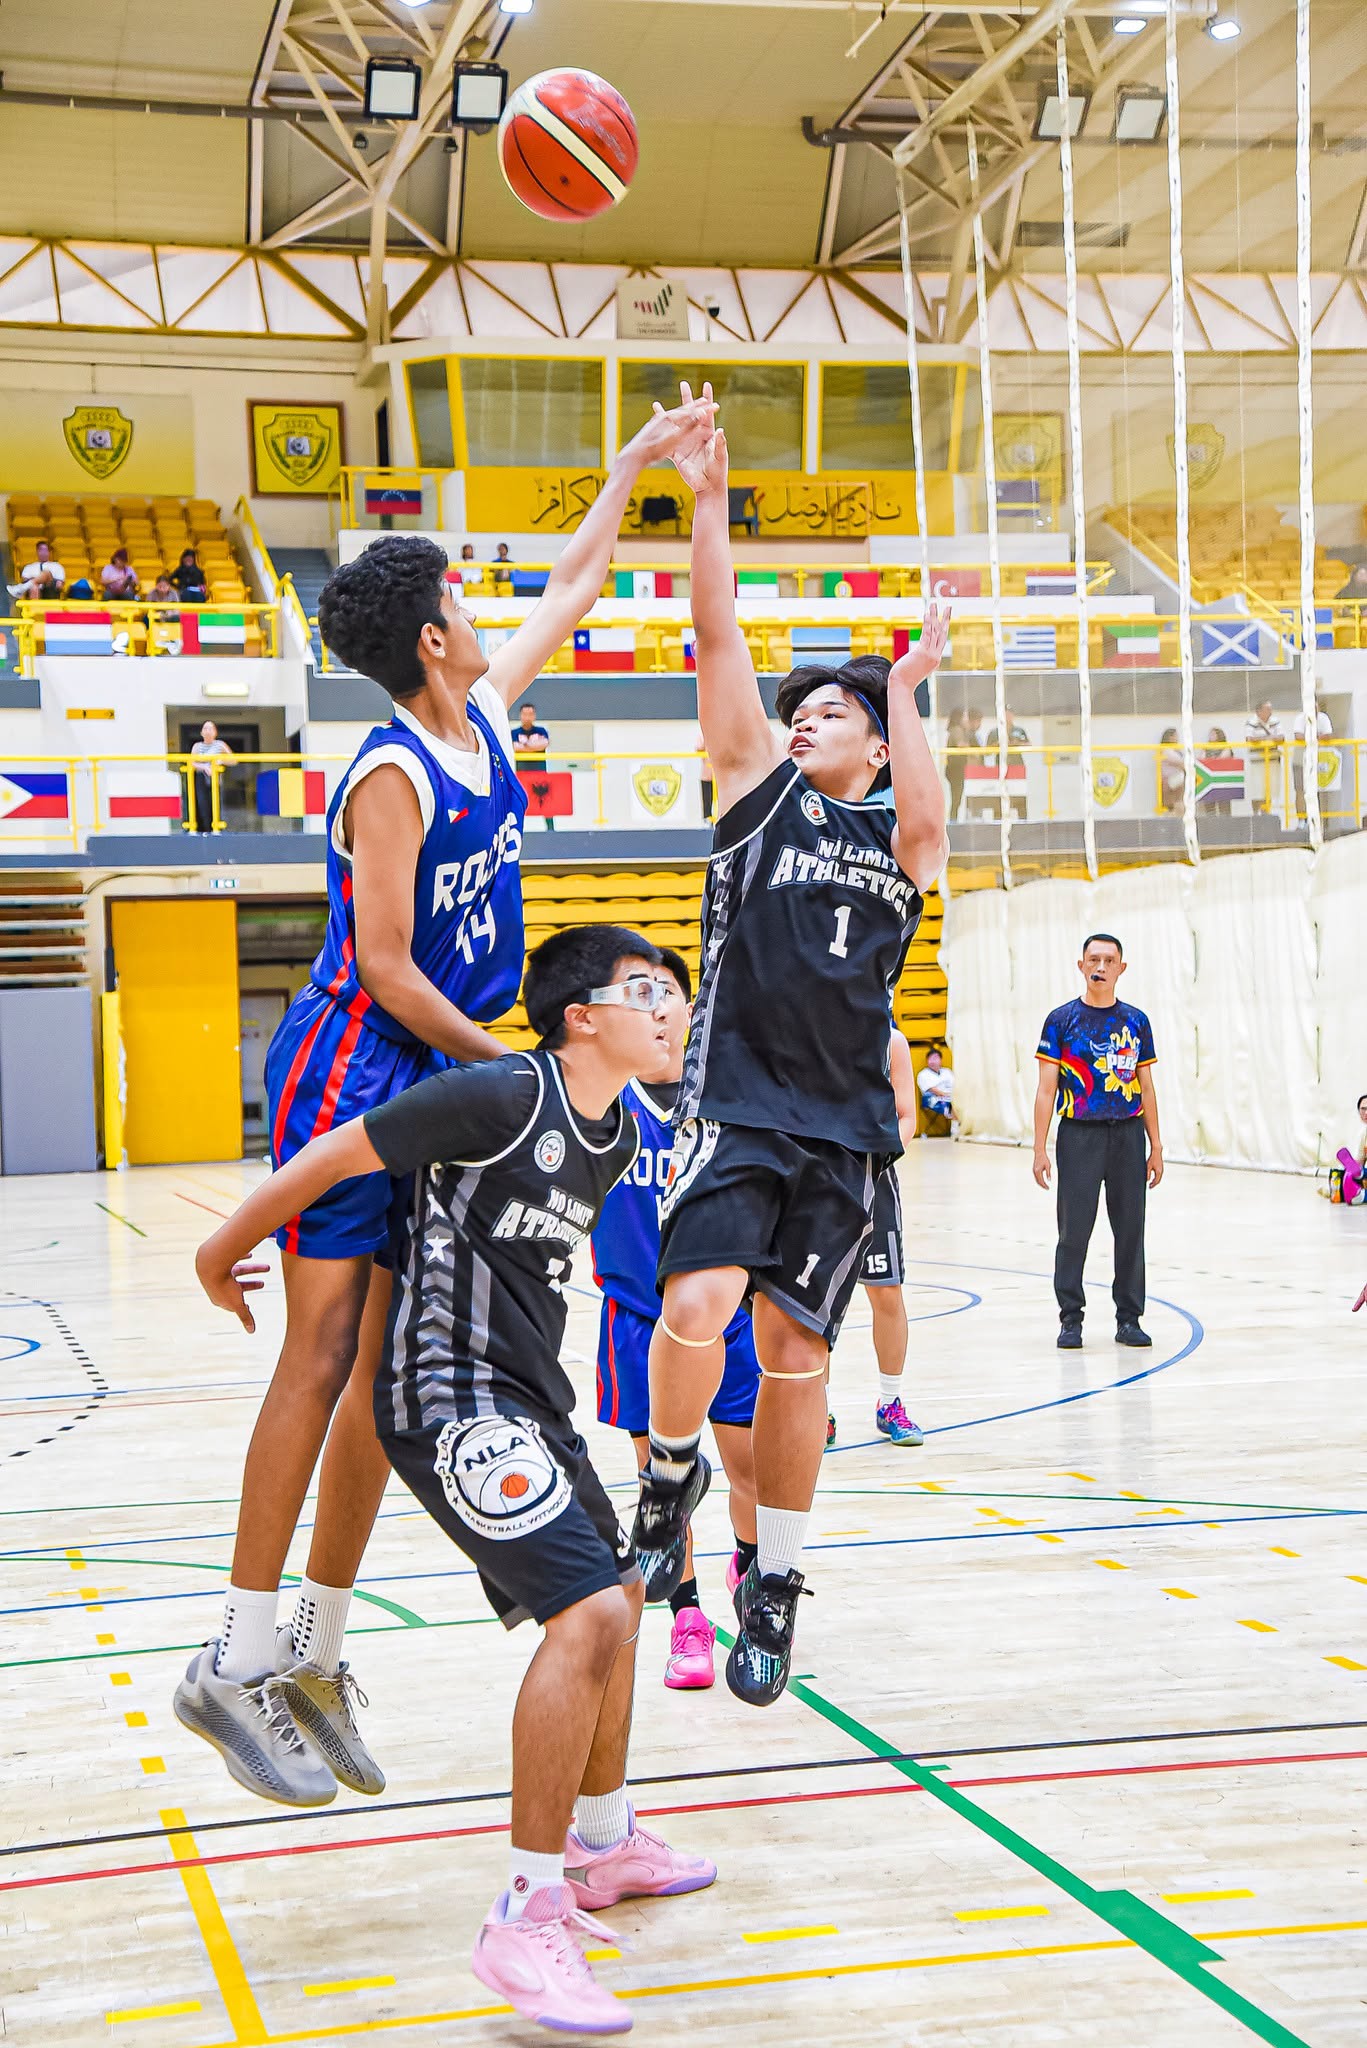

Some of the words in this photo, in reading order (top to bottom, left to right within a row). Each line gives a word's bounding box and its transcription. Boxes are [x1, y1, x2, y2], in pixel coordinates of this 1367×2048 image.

[829, 905, 852, 959] 1
[547, 1188, 567, 1213] NO
[796, 1253, 820, 1288] 1
[867, 1253, 887, 1274] 15
[464, 1437, 530, 1472] NLA
